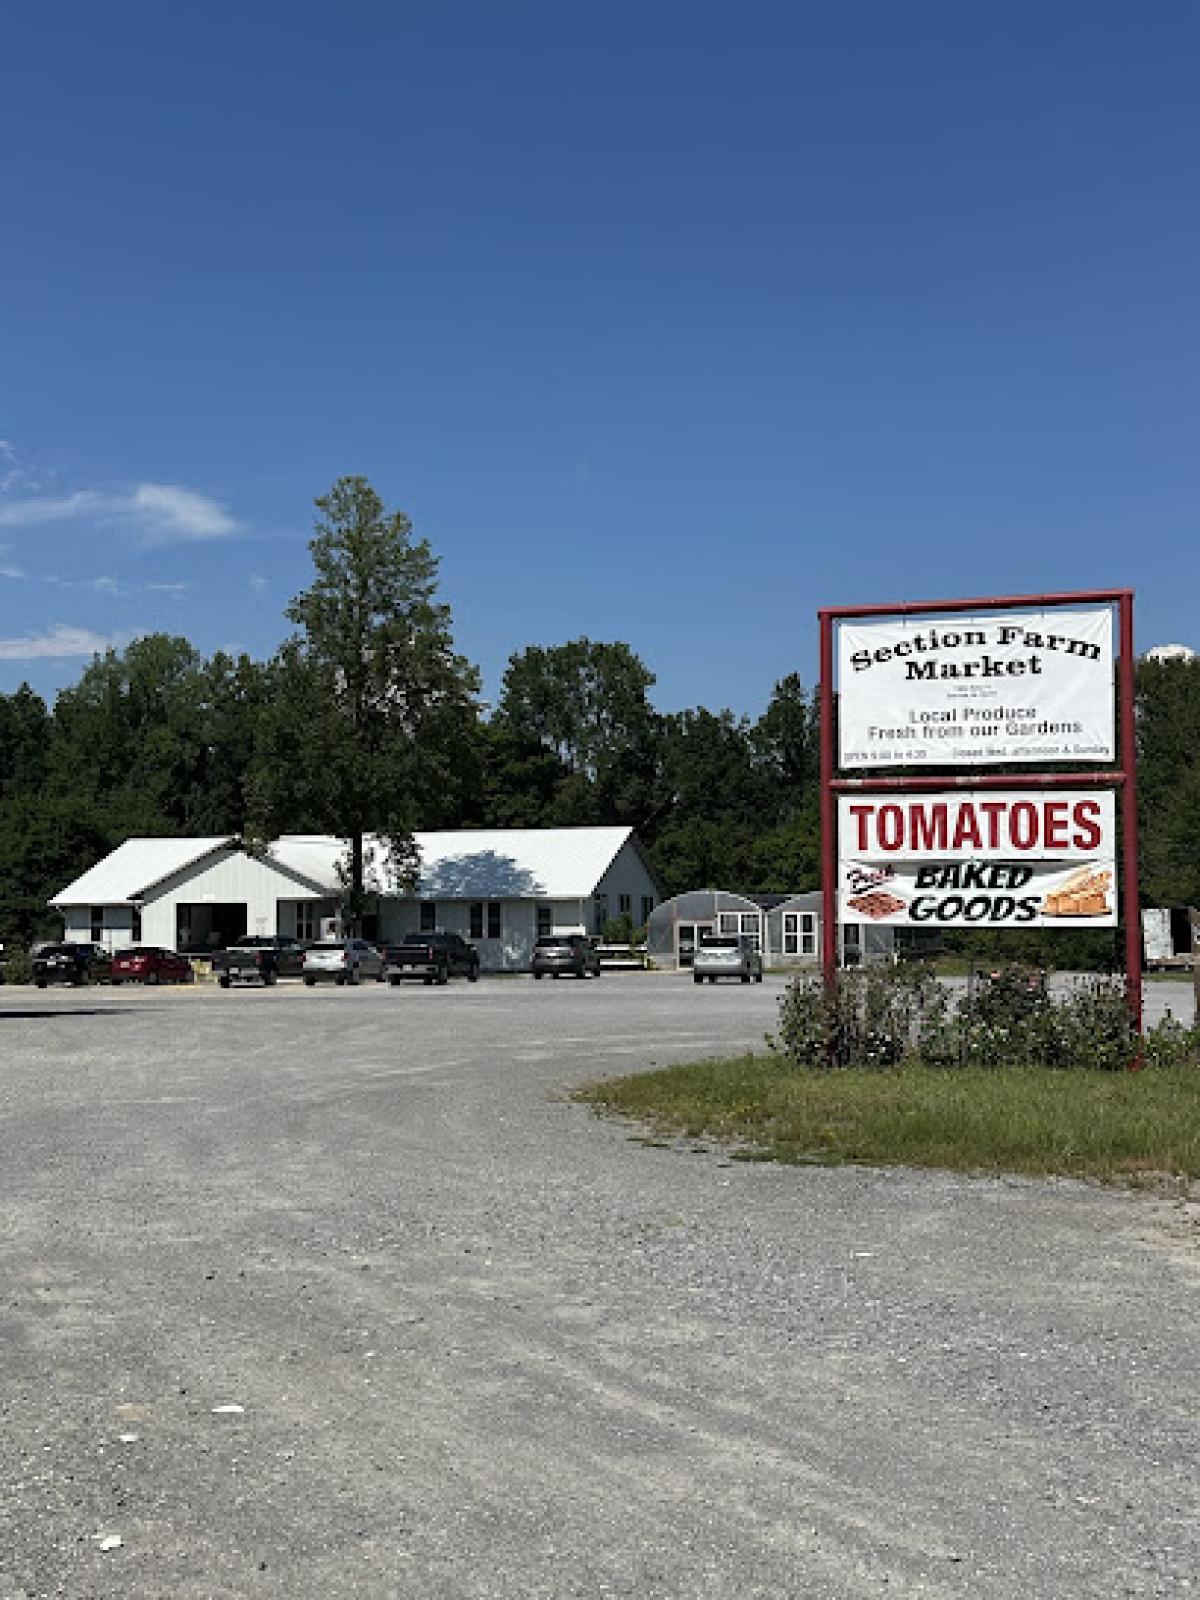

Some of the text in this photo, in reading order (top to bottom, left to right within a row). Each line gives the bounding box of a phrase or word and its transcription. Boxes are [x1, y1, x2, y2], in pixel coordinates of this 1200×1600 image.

[850, 626, 1101, 672] Section Farm
[905, 655, 1042, 680] Market
[909, 706, 1037, 724] Local Produce
[868, 719, 1083, 739] Fresh from our Gardens
[849, 800, 1102, 851] TOMATOES
[914, 863, 1034, 888] BAKED
[908, 896, 1042, 921] GOODS
